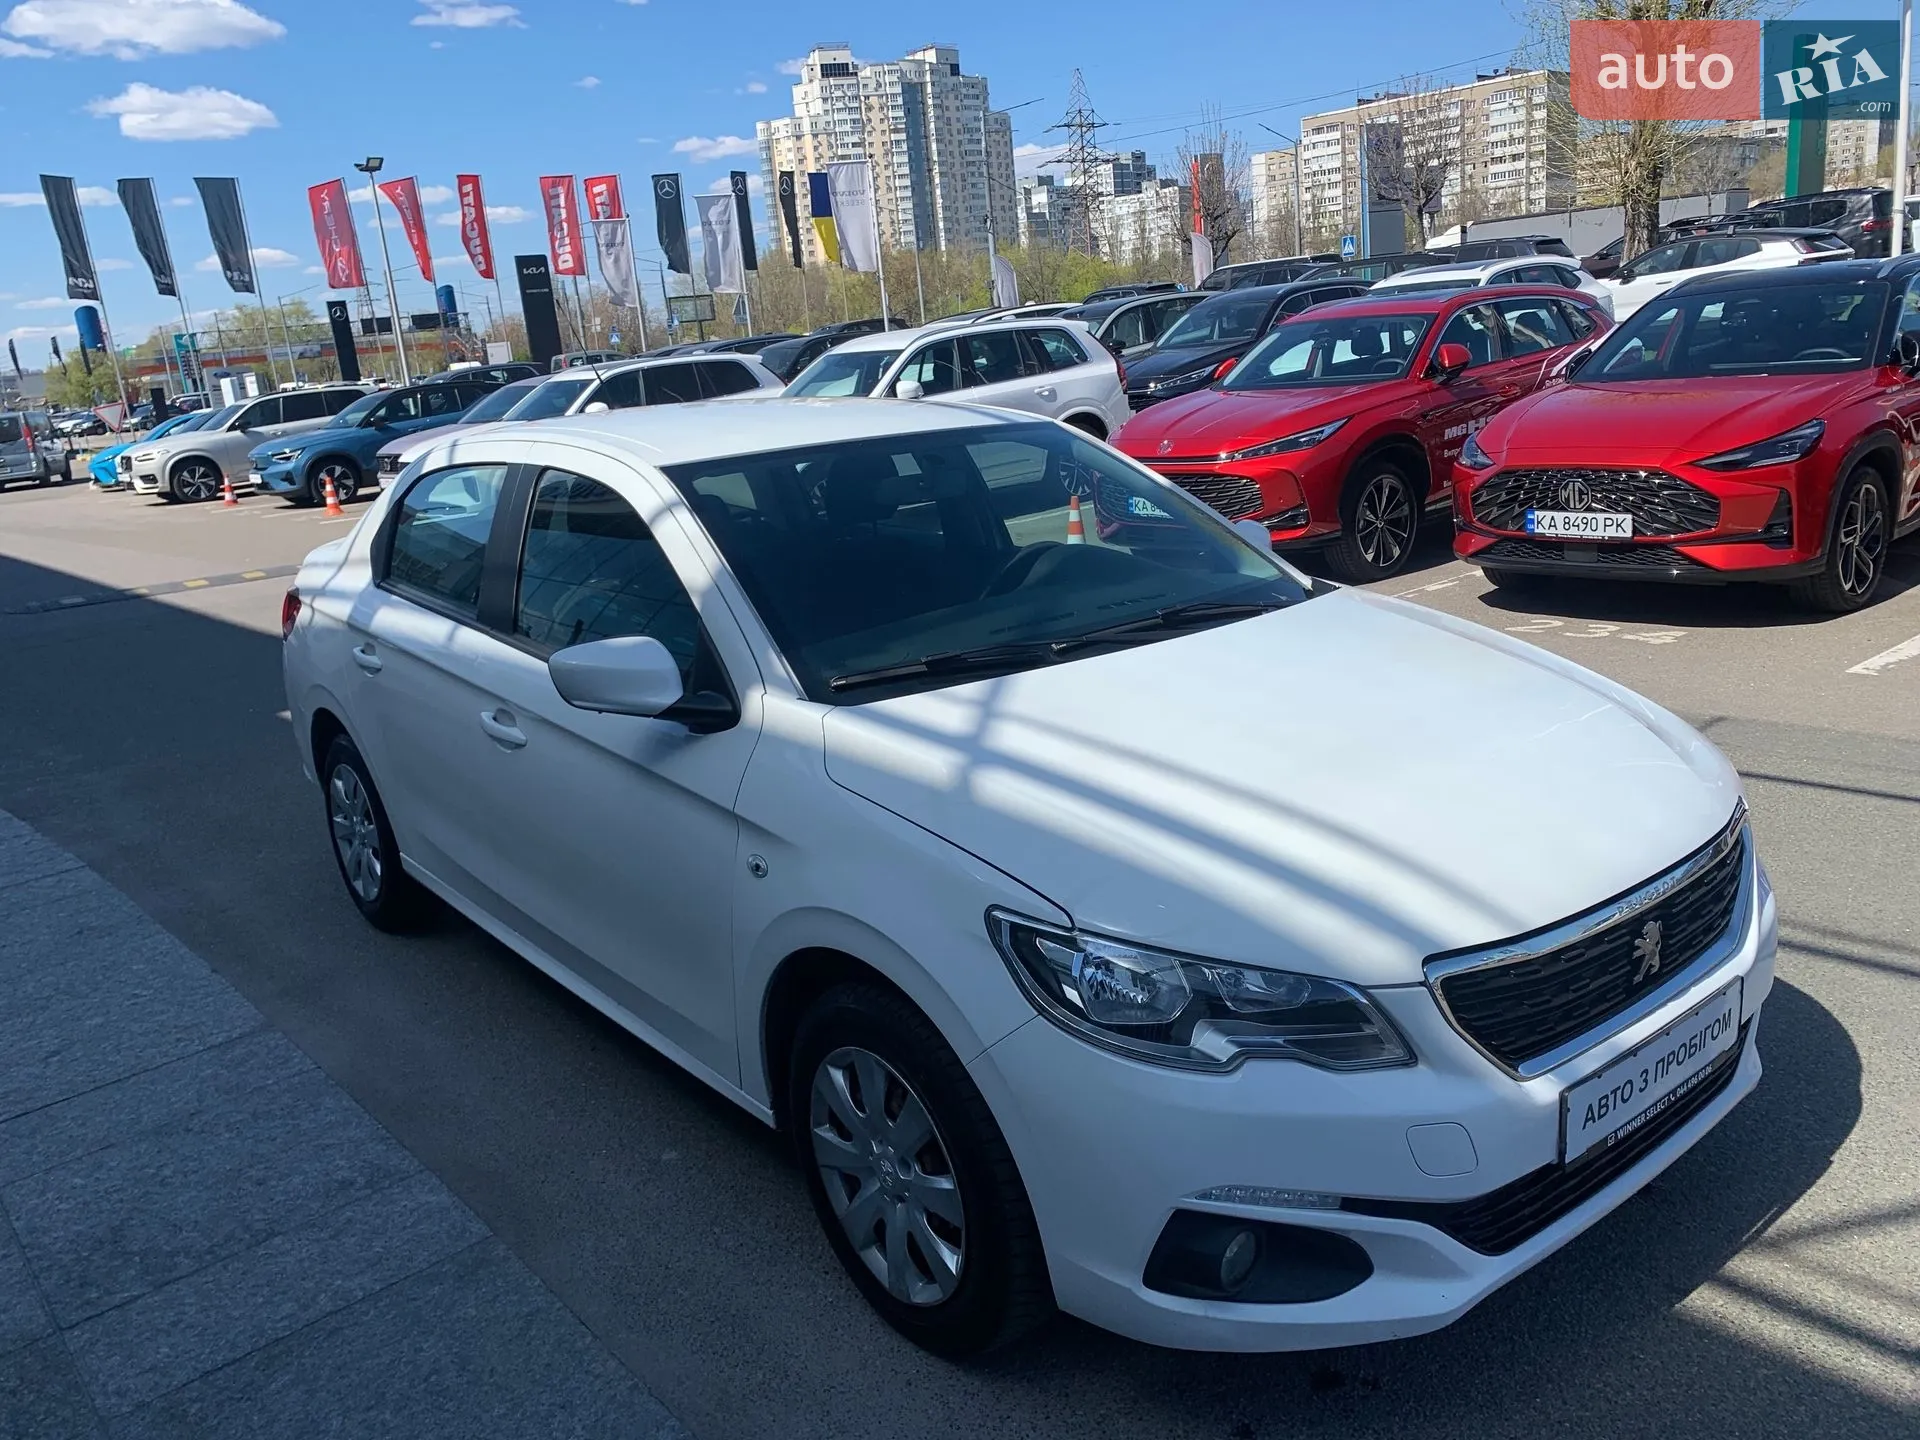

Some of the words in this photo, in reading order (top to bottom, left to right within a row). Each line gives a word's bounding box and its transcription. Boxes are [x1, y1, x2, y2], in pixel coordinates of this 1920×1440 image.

[1561, 481, 1589, 509] MG
[1536, 515, 1558, 531] KA
[1562, 515, 1599, 533] 8490
[1603, 517, 1627, 534] PK
[1582, 1080, 1634, 1130] АВТО
[1653, 1008, 1733, 1084] ПРОБІГОМ
[1616, 1110, 1647, 1140] WINNER
[1645, 1097, 1669, 1122] SELECT
